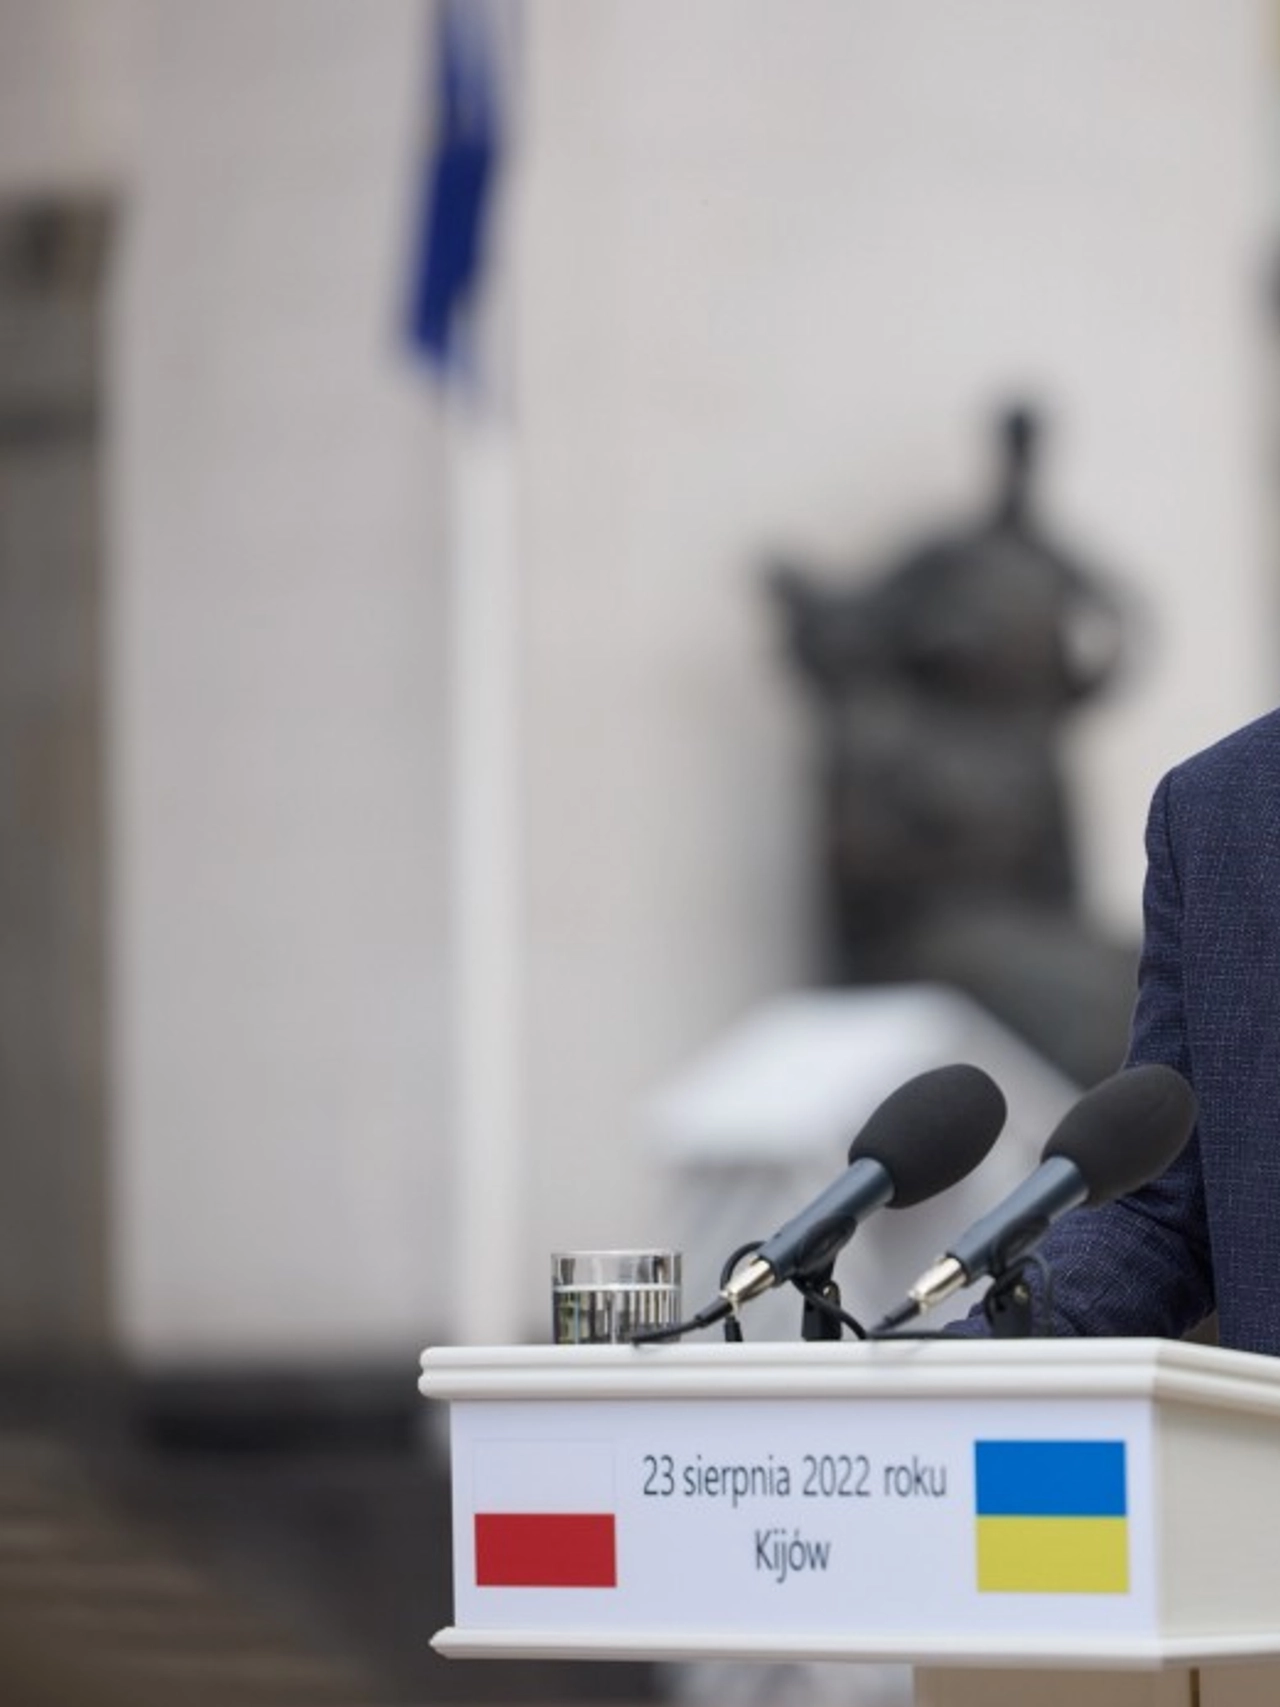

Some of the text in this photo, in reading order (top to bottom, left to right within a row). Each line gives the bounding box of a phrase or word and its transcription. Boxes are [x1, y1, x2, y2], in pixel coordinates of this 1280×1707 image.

[643, 1452, 947, 1508] 23 sierpnia 2022 roku
[754, 1526, 831, 1584] Kijów
